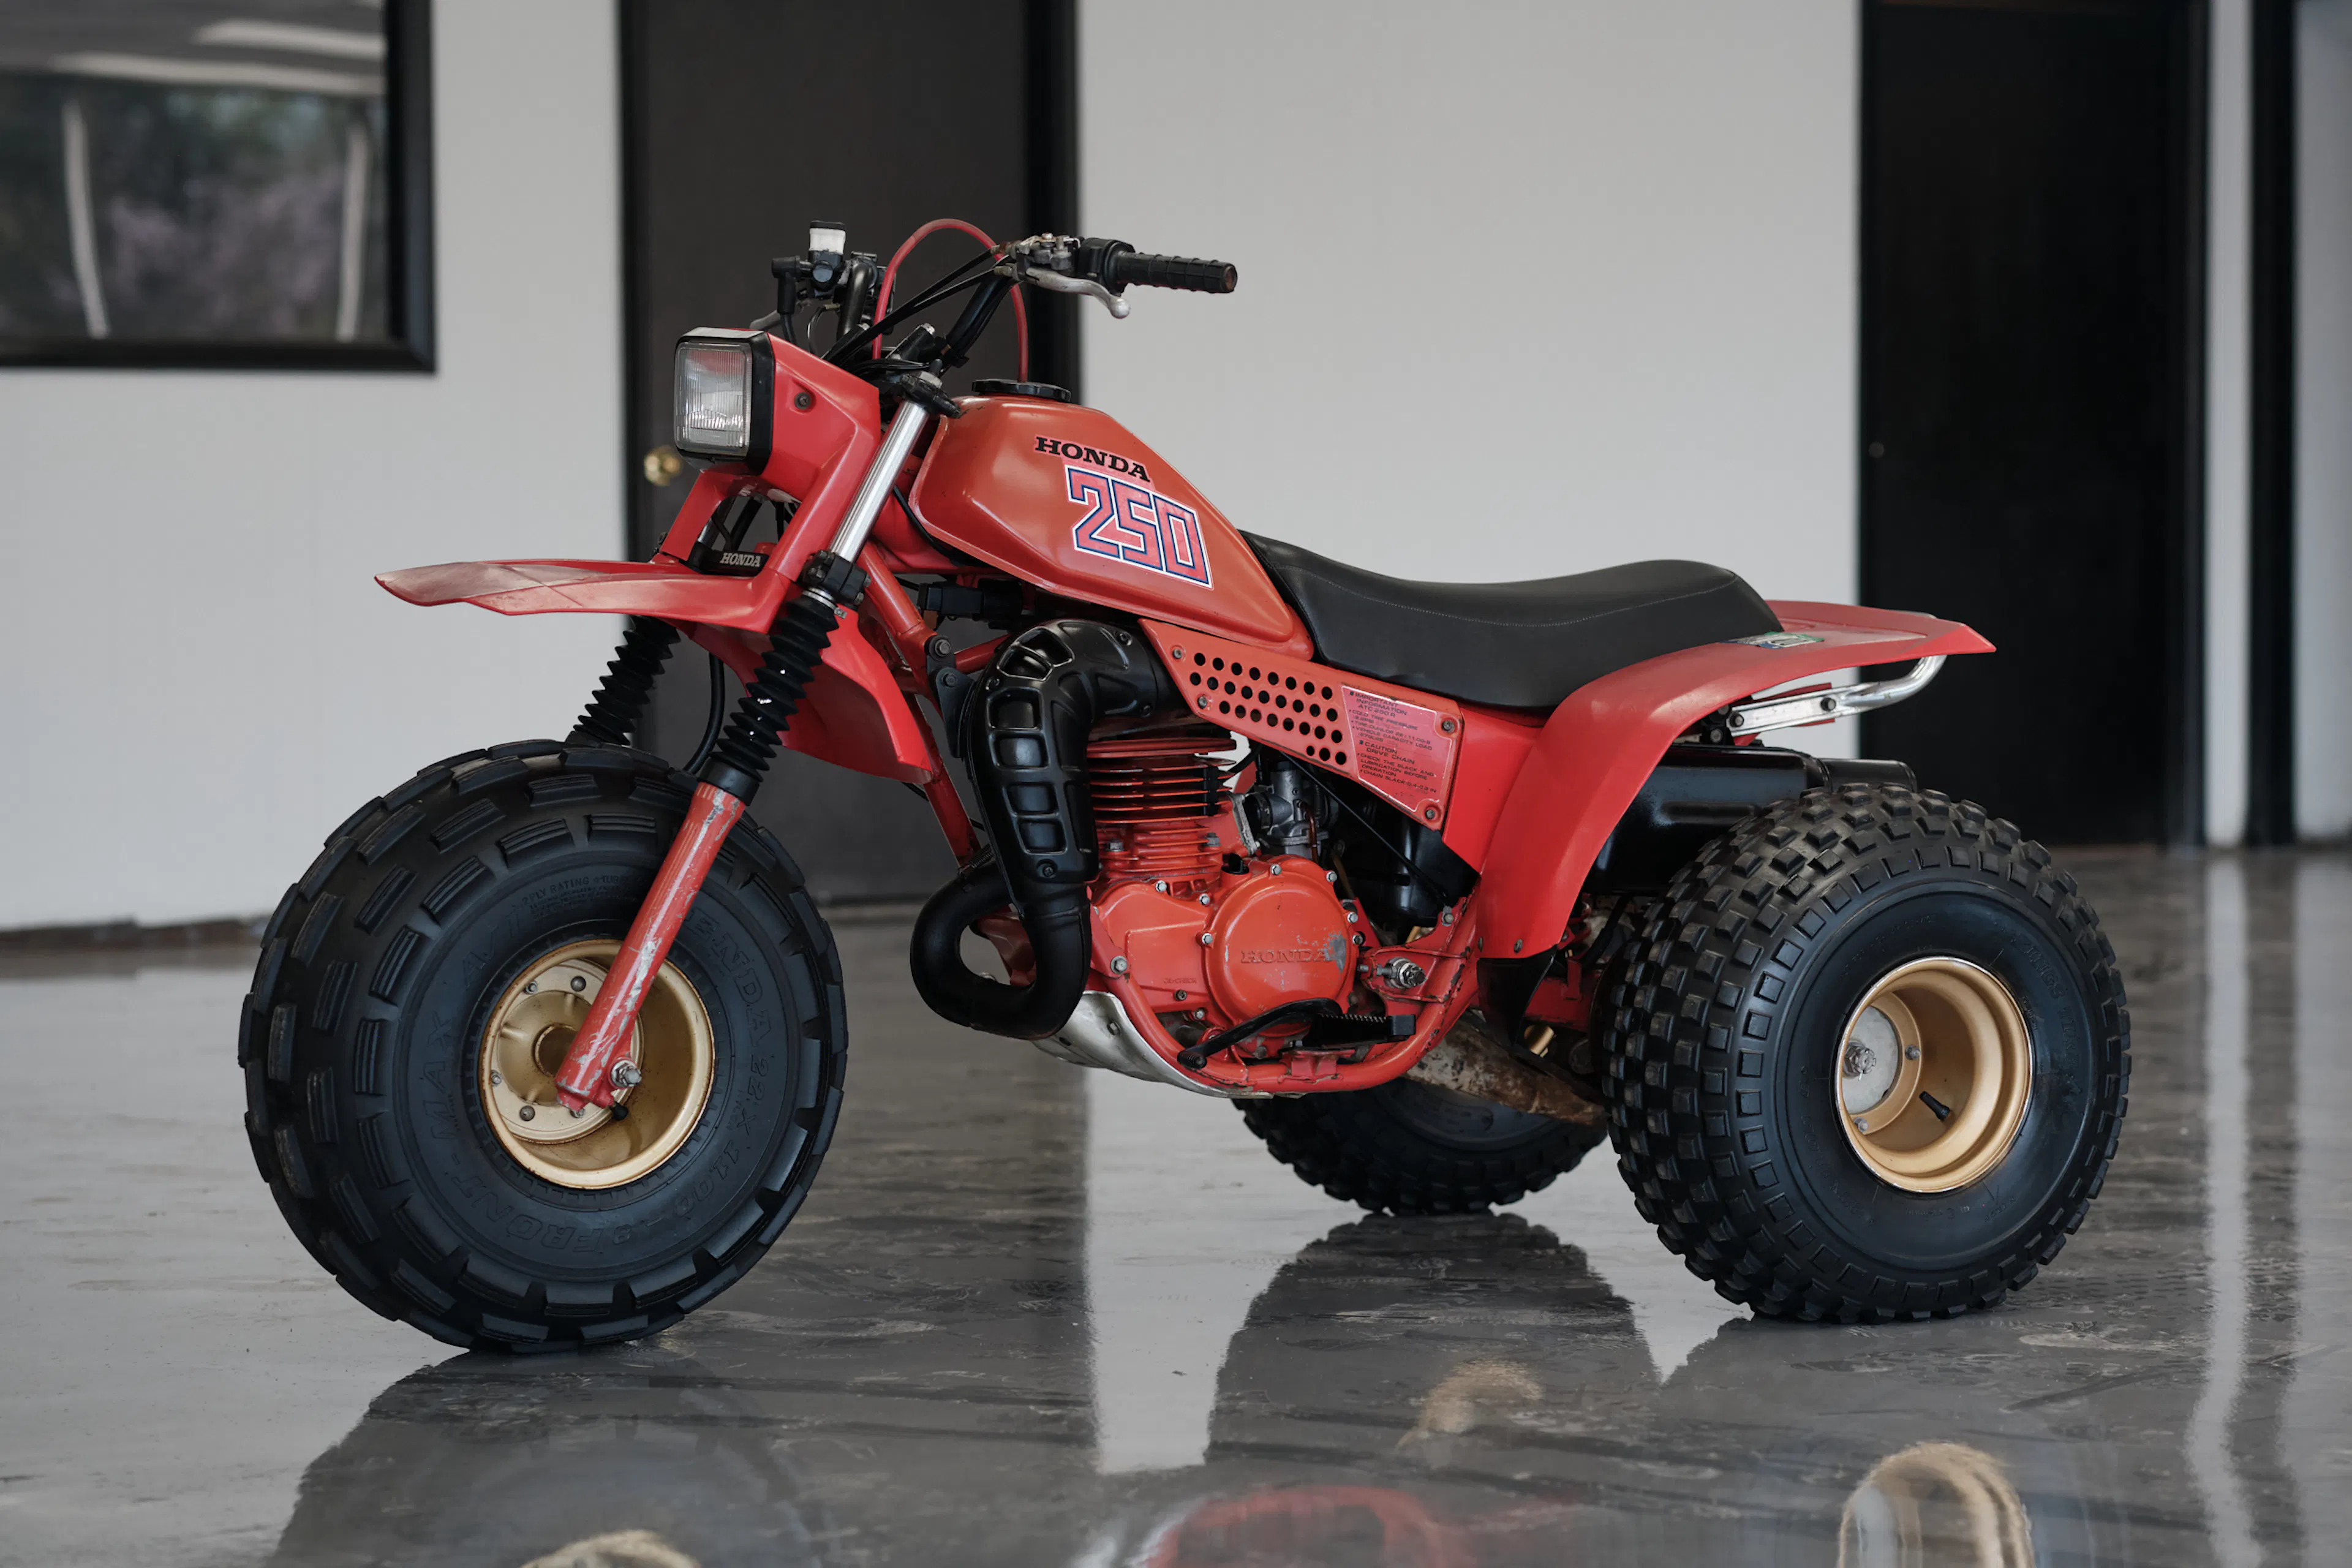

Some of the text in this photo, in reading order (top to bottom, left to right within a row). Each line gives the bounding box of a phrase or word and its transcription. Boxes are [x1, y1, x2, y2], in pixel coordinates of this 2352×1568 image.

[1035, 436, 1150, 482] HONDA
[1065, 464, 1213, 589] 250
[720, 552, 761, 567] HONDA
[1355, 692, 1398, 707] IMPORTANT
[1356, 698, 1408, 715] INFORMATION
[1364, 741, 1397, 754] CAUTION
[1415, 742, 1433, 750] LOAD
[1365, 747, 1415, 764] DRIVE CHAIN
[1360, 758, 1428, 780] LUBRICATION BEFORE
[1361, 764, 1396, 777] OPERATION
[1363, 769, 1383, 778] CHAIN
[1240, 949, 1333, 964] HONDA
[684, 905, 772, 1047] ENDA
